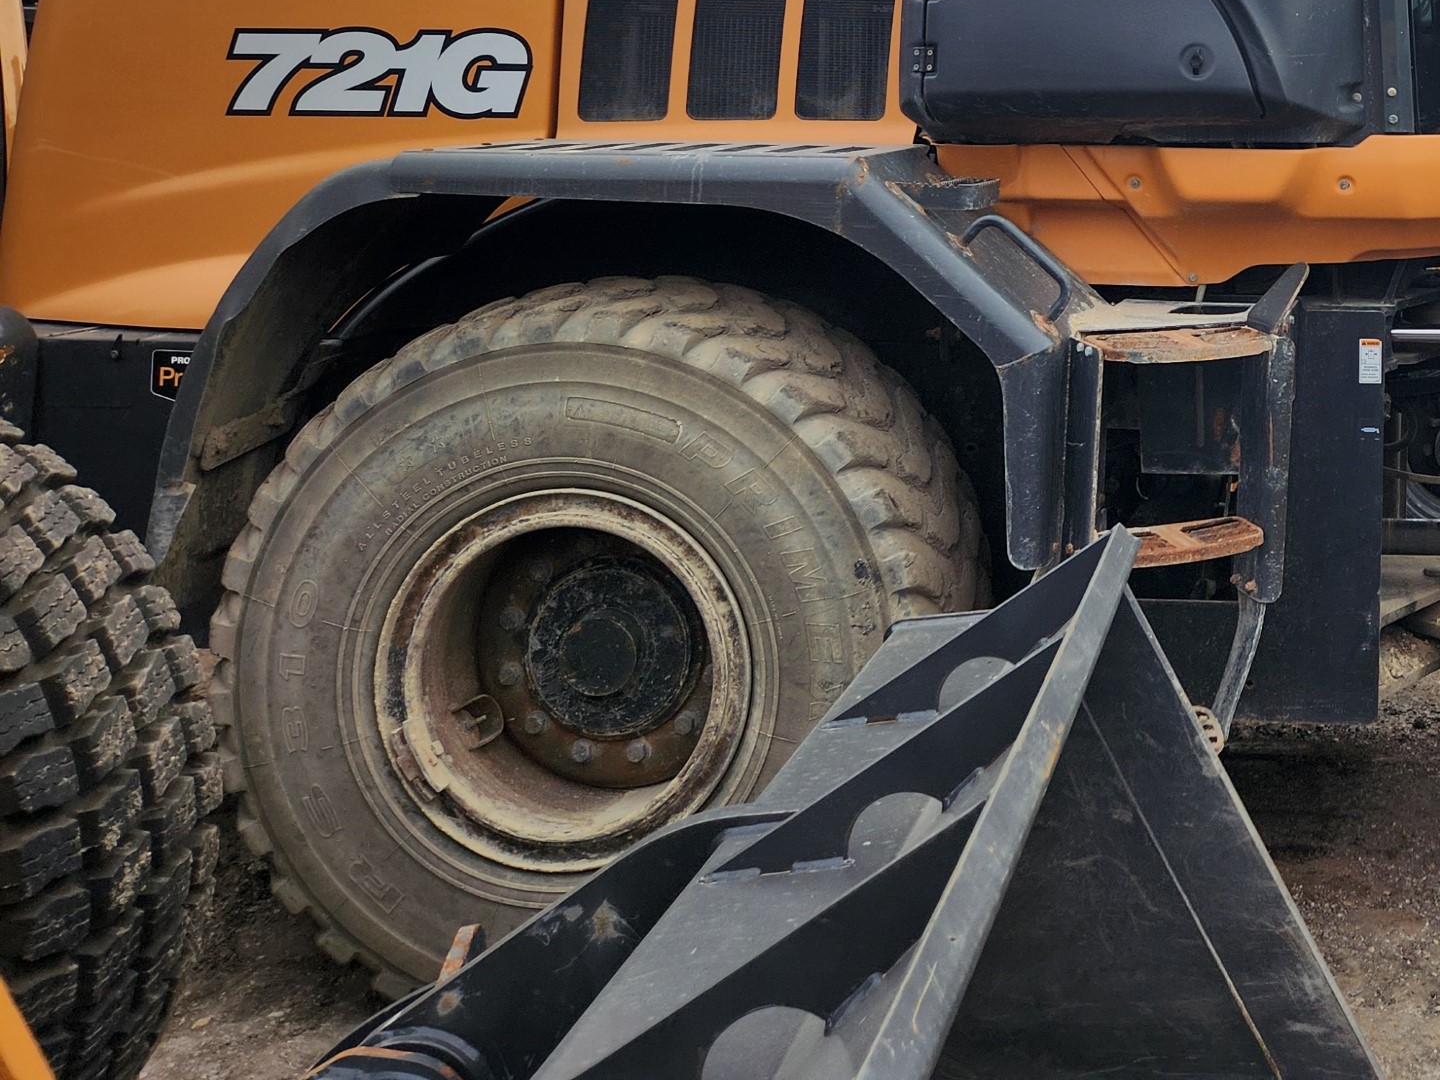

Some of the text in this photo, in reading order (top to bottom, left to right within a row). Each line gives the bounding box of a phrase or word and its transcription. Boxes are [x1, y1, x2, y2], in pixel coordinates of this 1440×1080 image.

[225, 26, 533, 119] 721G
[159, 366, 184, 387] Pr
[170, 356, 191, 365] PRO
[382, 477, 432, 518] STEEL
[435, 437, 533, 477] TUBELESS
[422, 455, 508, 501] CONSTRUCTION
